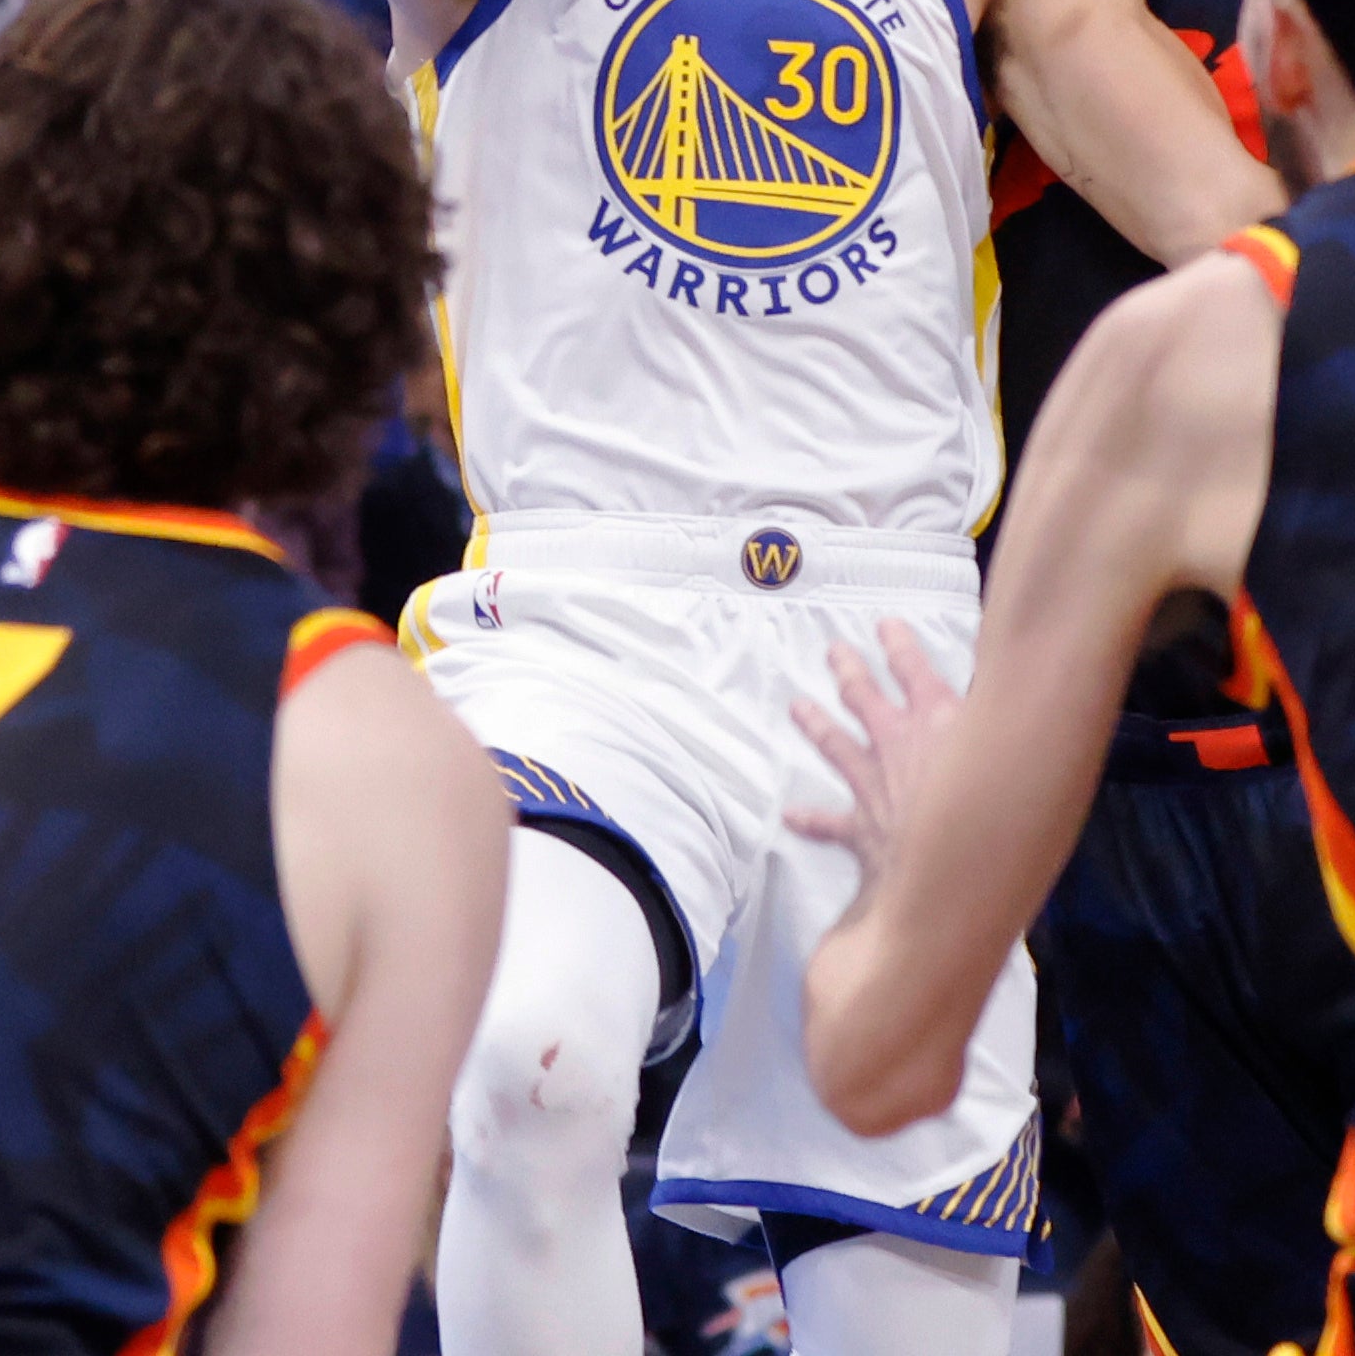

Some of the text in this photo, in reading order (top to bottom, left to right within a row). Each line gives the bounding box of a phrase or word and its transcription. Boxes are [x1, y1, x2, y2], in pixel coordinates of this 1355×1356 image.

[764, 38, 869, 125] 30
[587, 195, 898, 317] WARRIORS
[747, 541, 799, 582] W
